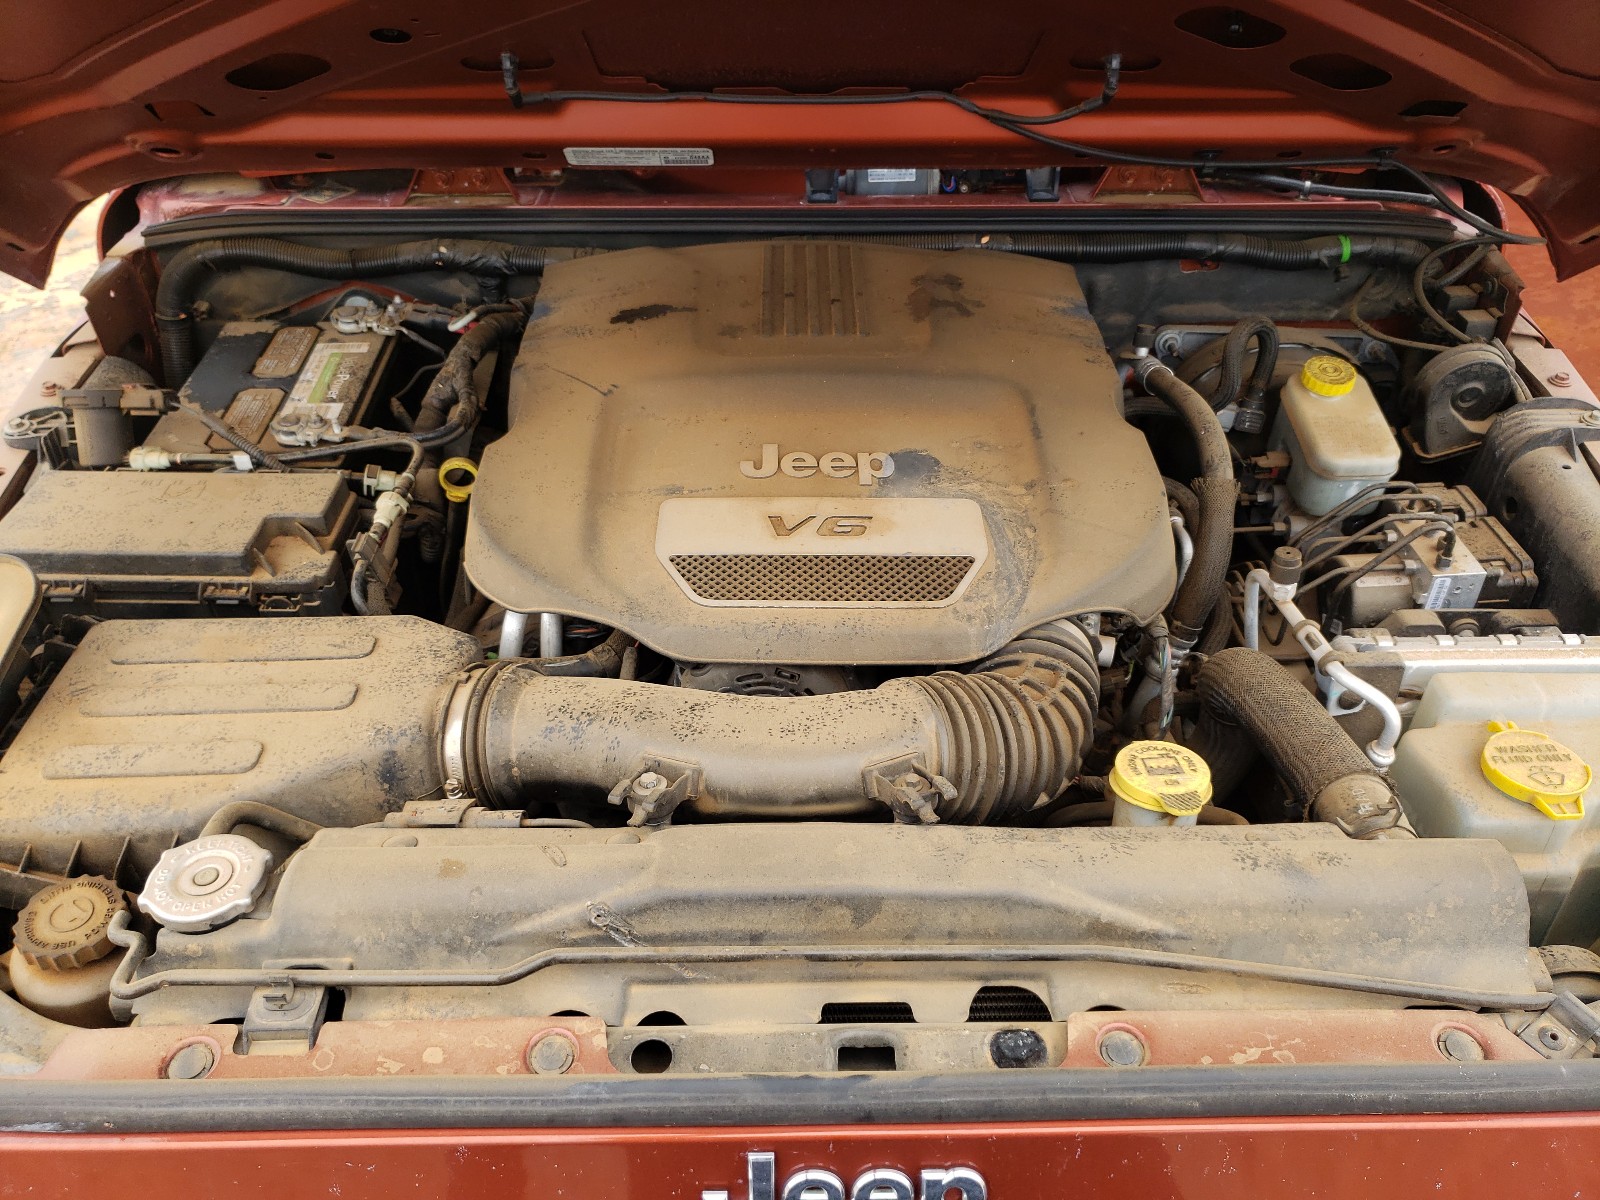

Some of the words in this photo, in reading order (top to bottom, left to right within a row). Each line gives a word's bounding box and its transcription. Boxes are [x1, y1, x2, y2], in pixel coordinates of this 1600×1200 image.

[739, 443, 895, 487] Jeep
[767, 515, 874, 537] V6
[1136, 745, 1182, 755] COOLANT
[1181, 755, 1198, 773] ONLY
[1491, 755, 1533, 764] FLUID
[1536, 753, 1573, 763] ONLY
[1493, 743, 1558, 754] WASHER
[171, 900, 212, 912] OPEN
[218, 883, 243, 903] HOT
